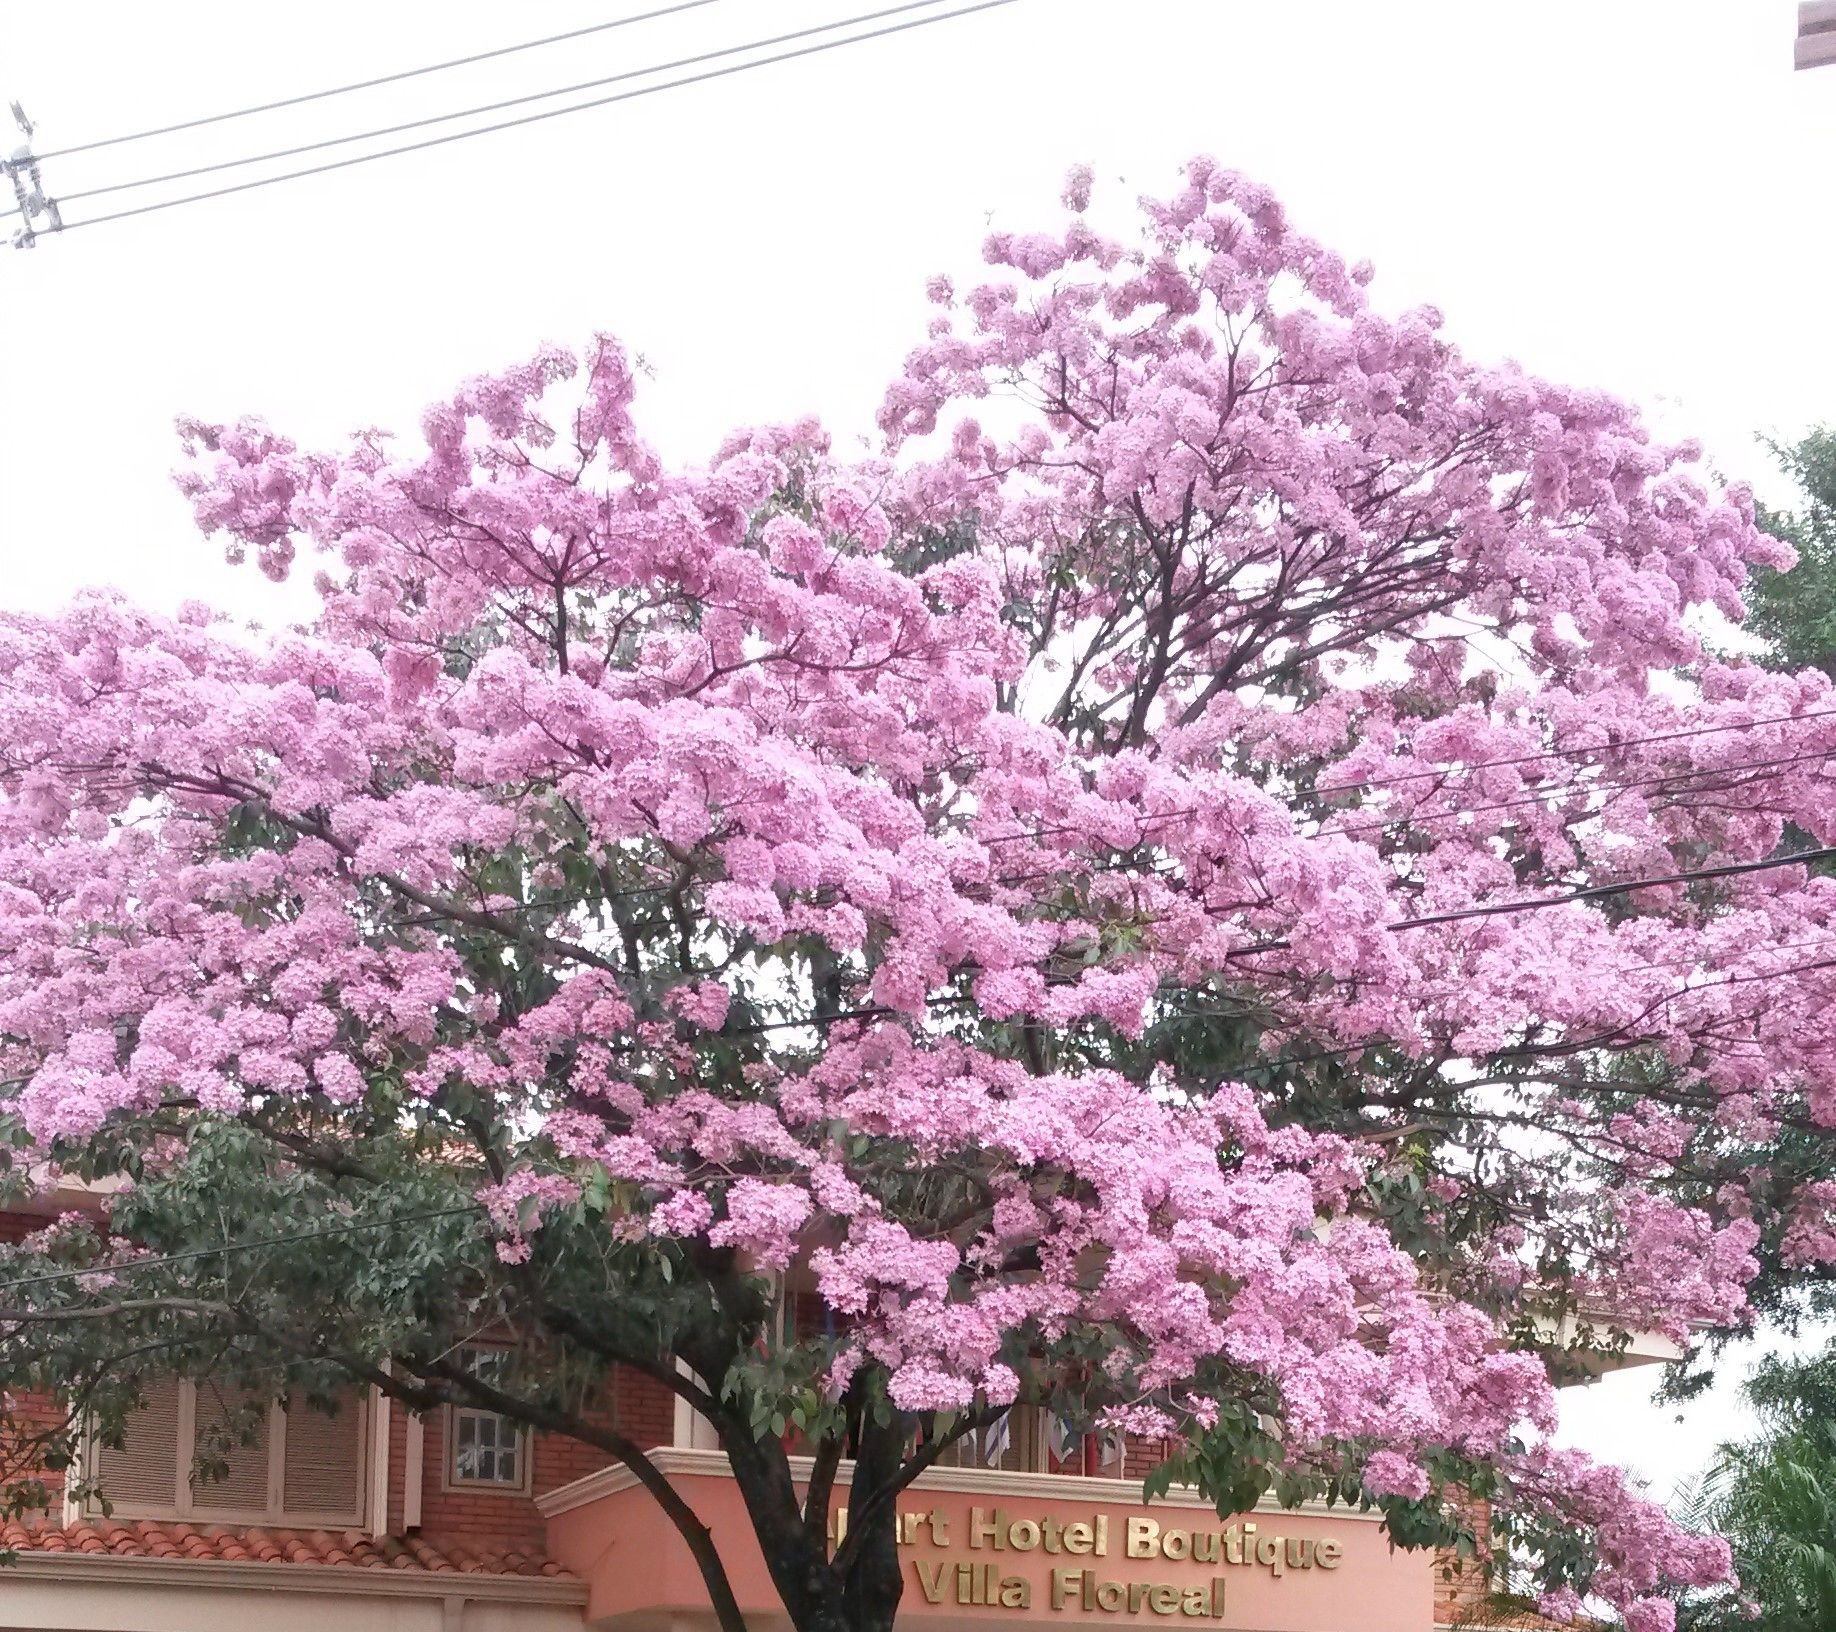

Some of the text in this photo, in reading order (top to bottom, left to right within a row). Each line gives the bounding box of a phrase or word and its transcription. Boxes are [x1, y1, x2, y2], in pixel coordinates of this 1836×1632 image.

[970, 1506, 1109, 1557] Hotel
[1126, 1516, 1344, 1578] Boutique
[914, 1560, 1226, 1619] Villa Floreal
